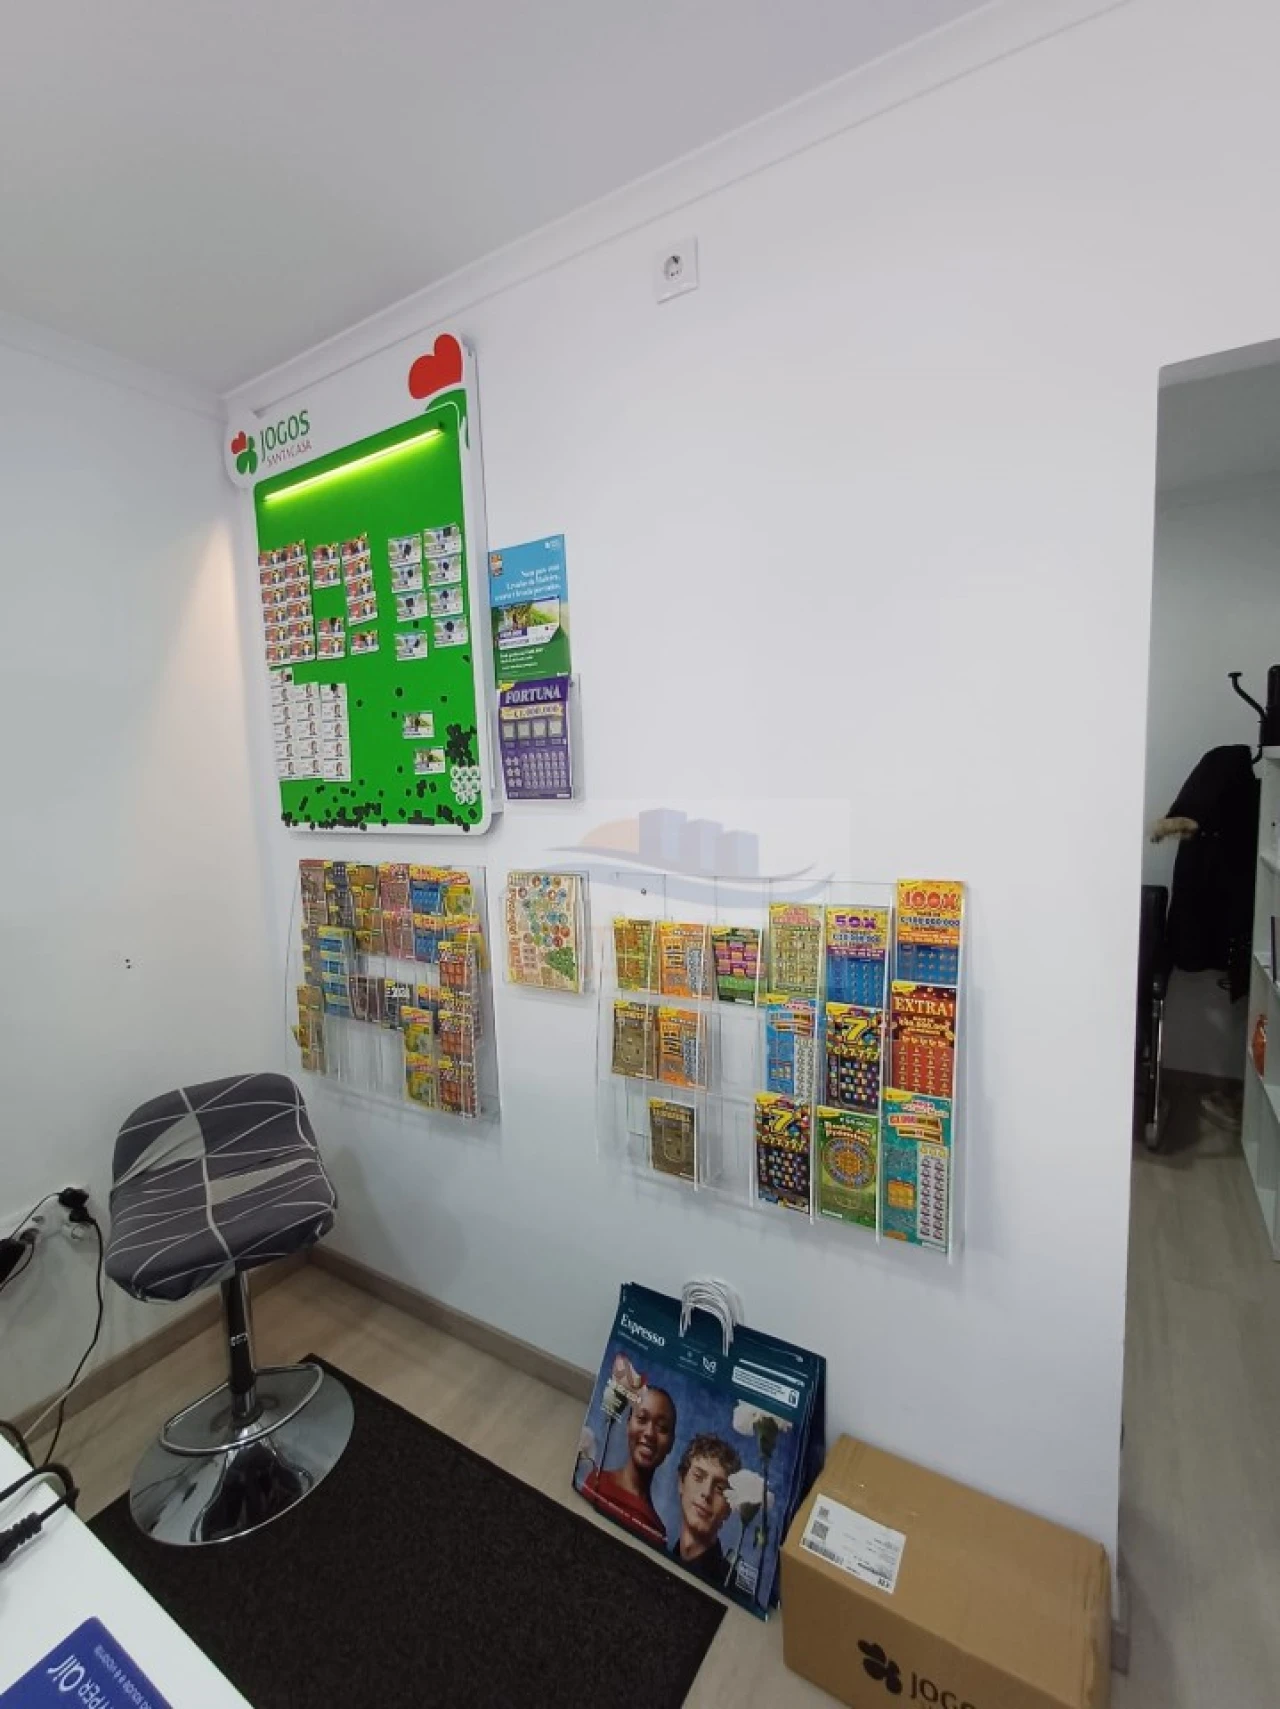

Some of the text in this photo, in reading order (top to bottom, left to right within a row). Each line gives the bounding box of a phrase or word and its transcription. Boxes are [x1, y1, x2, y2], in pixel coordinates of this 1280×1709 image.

[259, 409, 310, 463] JOGOS
[505, 683, 562, 704] FORTUNA
[903, 890, 958, 911] 100X
[834, 914, 877, 930] 50X
[893, 996, 954, 1018] EXTRA!
[842, 1015, 870, 1044] 7
[768, 1106, 795, 1134] 7
[620, 1313, 665, 1347] Expresso
